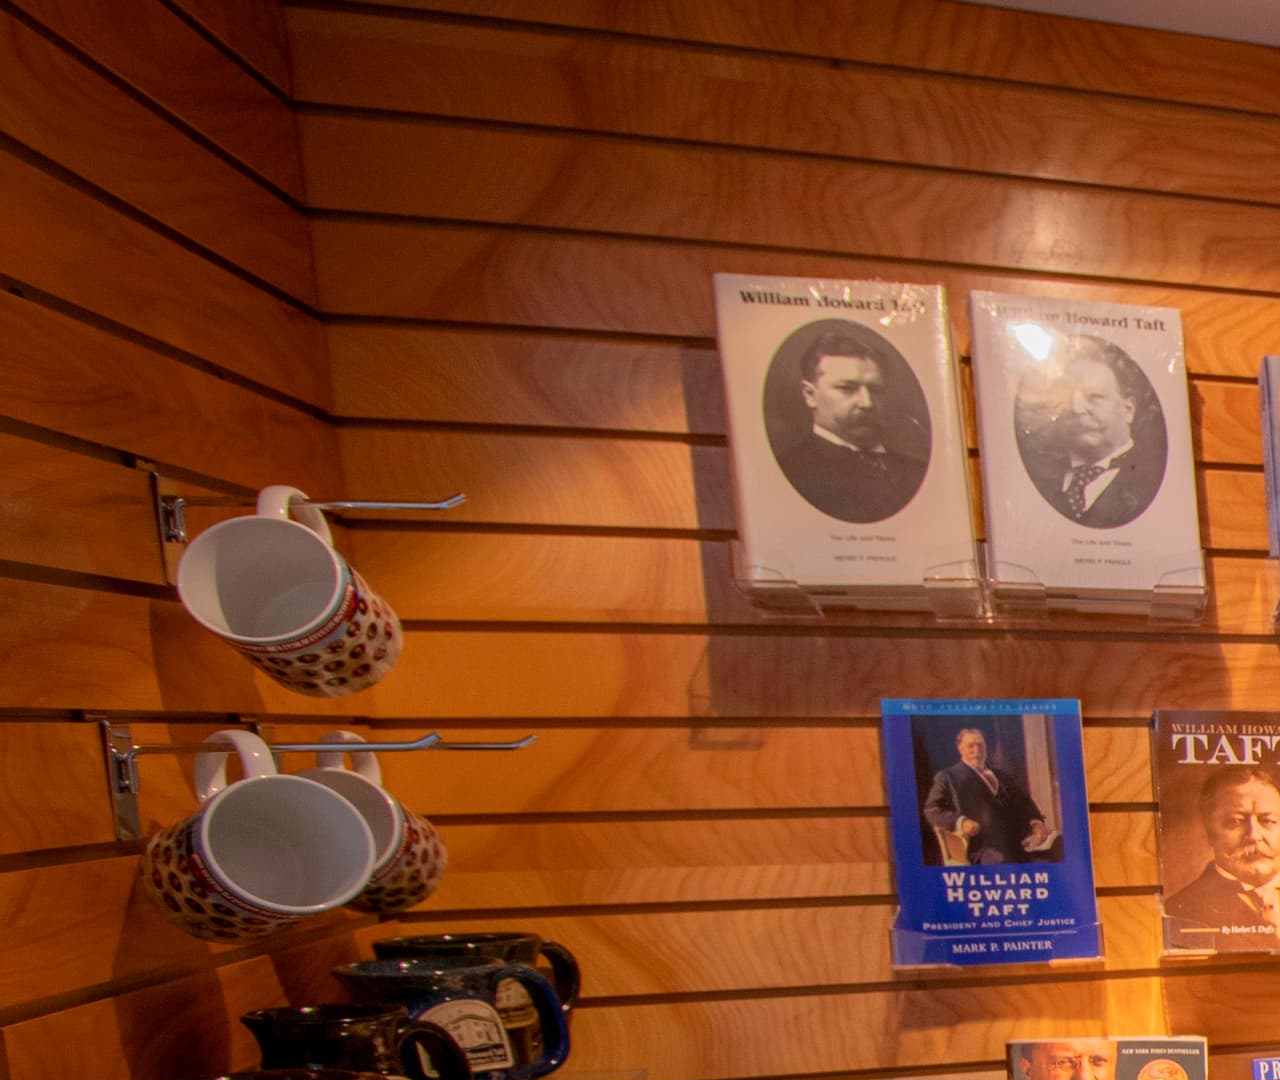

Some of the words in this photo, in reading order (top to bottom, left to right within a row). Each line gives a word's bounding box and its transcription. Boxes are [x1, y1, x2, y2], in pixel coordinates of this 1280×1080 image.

[1066, 312, 1128, 328] Howard
[1134, 318, 1165, 332] Taft
[1172, 724, 1237, 734] WILLIAM
[943, 872, 1049, 886] WILLIAM
[947, 888, 1049, 902] HOWARD
[968, 903, 1029, 917] TAFT
[952, 943, 986, 953] MARK
[991, 943, 1000, 952] P.
[1003, 941, 1052, 951] PAINTER
